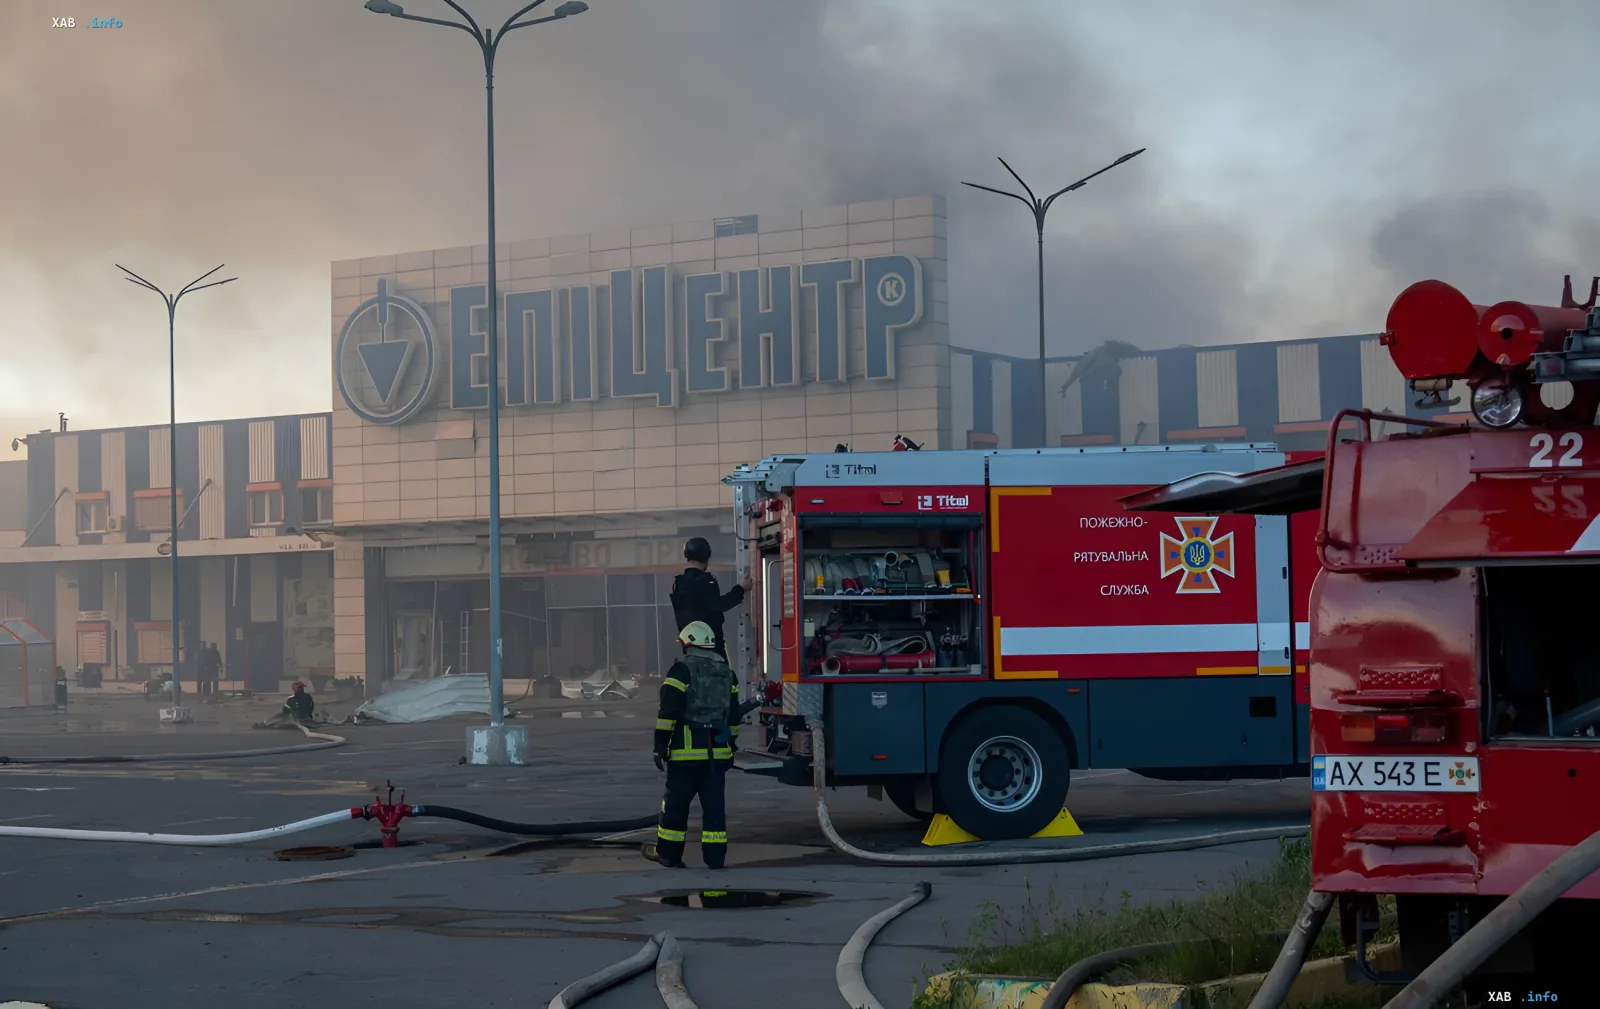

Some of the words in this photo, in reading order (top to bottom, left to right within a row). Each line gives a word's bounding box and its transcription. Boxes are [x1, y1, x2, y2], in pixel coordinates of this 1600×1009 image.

[450, 255, 923, 408] ЕПІЦЕНТР
[1529, 431, 1583, 468] 22
[1079, 516, 1148, 529] ПОЖЕЖНО-
[1073, 551, 1149, 563] РЯТУВАЛЬНА
[1100, 584, 1149, 596] СЛУЖБА
[1330, 761, 1364, 786] AX
[1373, 761, 1415, 786] 543
[1424, 761, 1442, 786] E
